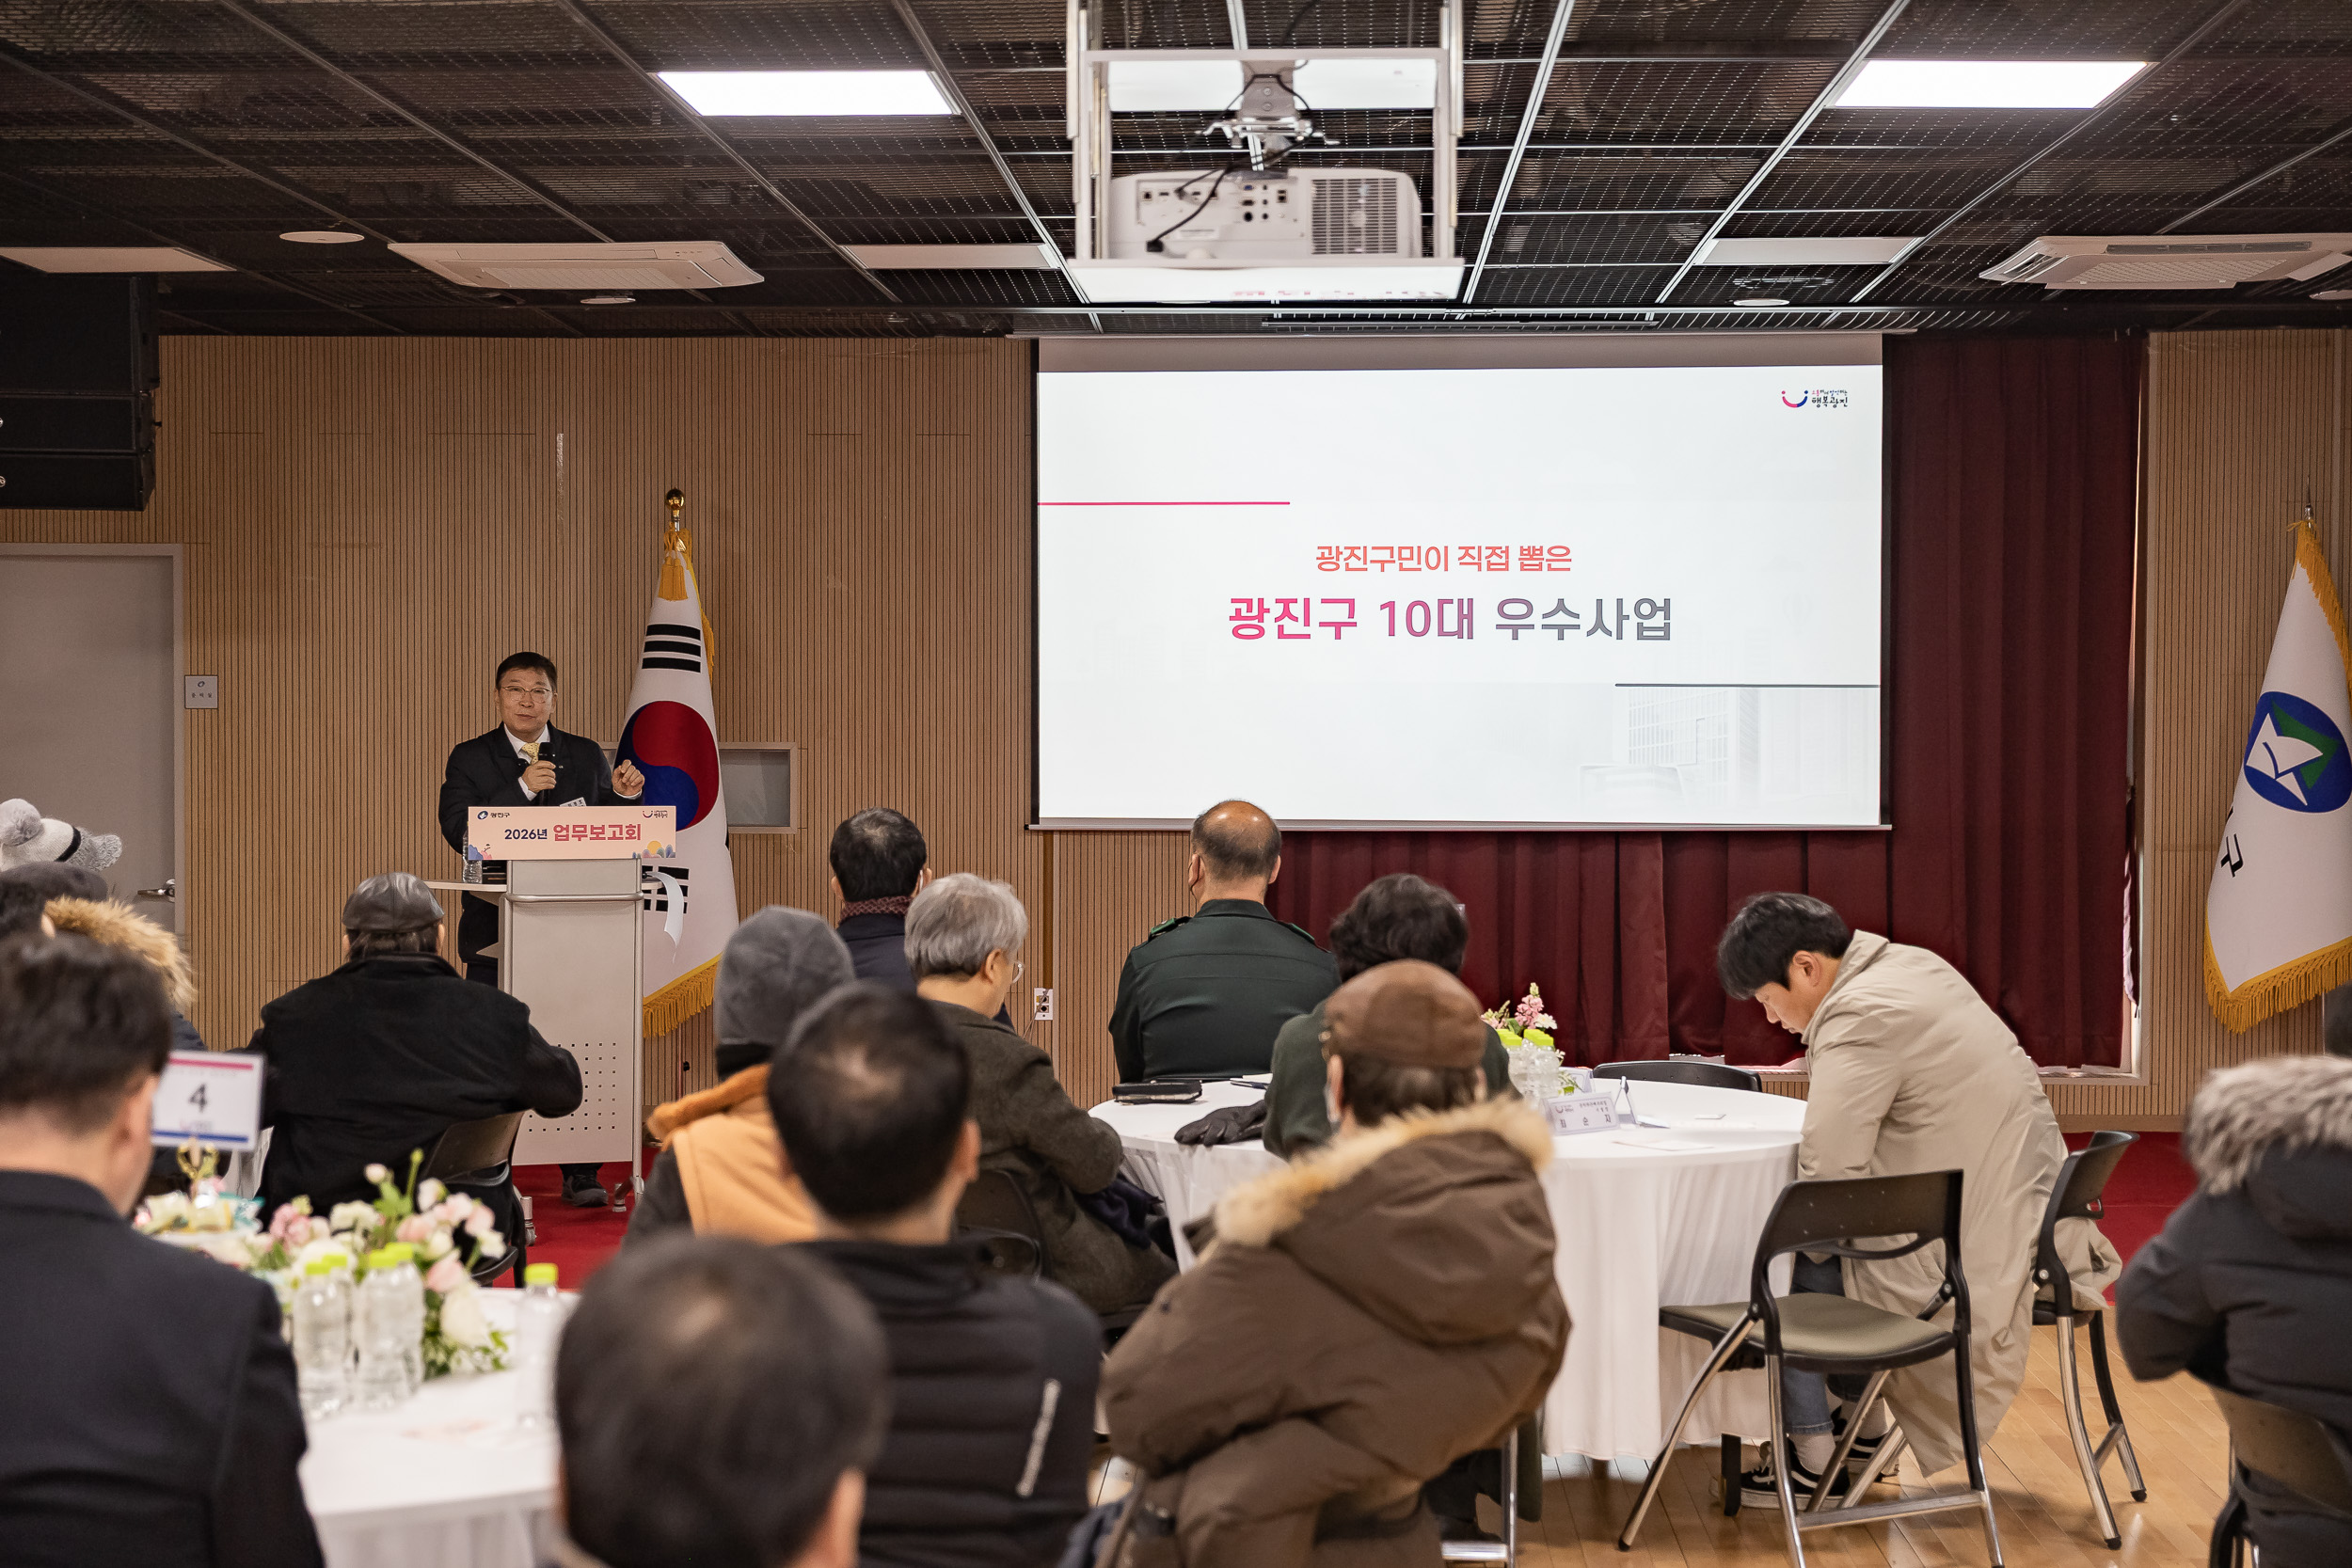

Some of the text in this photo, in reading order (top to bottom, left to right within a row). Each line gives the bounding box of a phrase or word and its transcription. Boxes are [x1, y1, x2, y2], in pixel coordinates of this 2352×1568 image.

[1811, 397, 1848, 408] 행복광진
[1315, 545, 1572, 573] 광진구민이 직접 뽑은
[1229, 597, 1672, 641] 광진구 10대 우수사업
[504, 823, 642, 842] 2026년 업무보고회
[189, 1084, 208, 1113] 4
